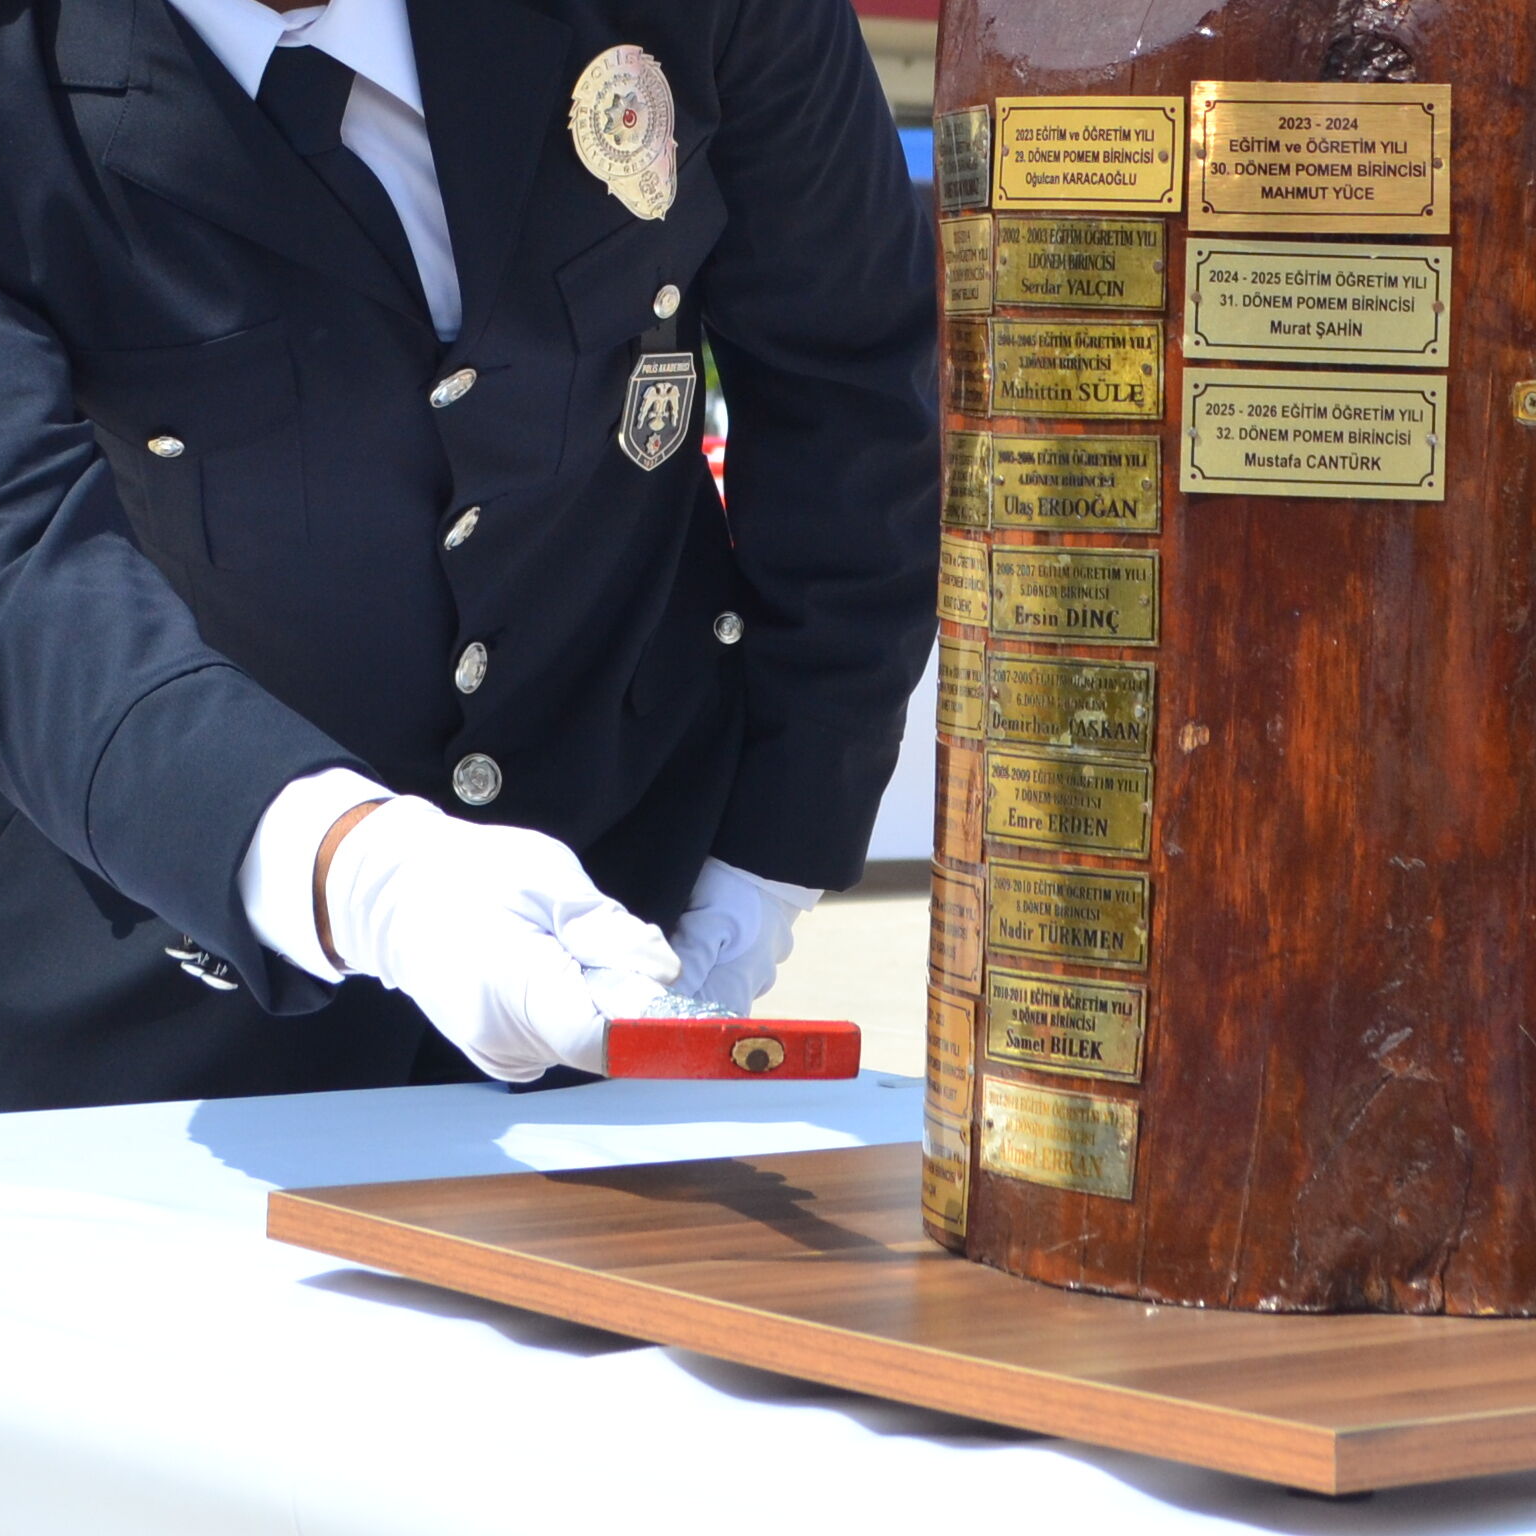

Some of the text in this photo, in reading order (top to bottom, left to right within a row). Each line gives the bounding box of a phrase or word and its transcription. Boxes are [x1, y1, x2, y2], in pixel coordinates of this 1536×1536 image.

[1016, 125, 1154, 142] 2023 EĞİTİM ve ÖĞRETİM YILI
[1278, 117, 1312, 130] 2023
[1325, 117, 1358, 130] 2024
[1028, 147, 1060, 163] DÖNEM
[1063, 151, 1100, 163] POMEM
[1103, 147, 1153, 164] BİRİNCİSİ
[1229, 137, 1408, 154] EĞİTİM ve ÖĞRETİM YILI
[1026, 169, 1137, 187] Oğulcan KARACAOĞLU
[1210, 160, 1427, 177] 30. DÖNEM POMEM BİRİNCİSİ
[1261, 184, 1374, 200] MAHMUT YÜCE
[1021, 278, 1124, 299] Serdar YALÇIN
[1209, 270, 1239, 283] 2024
[1251, 272, 1281, 285] 2025
[1285, 270, 1331, 287] EĞİTİM
[1336, 271, 1398, 289] ÖĞRETİM
[1401, 276, 1427, 290] YILI
[1220, 292, 1415, 313] 31. DÖNEM POMEM BİRİNCİSİ
[1270, 318, 1363, 339] Murat ŞAHİN
[1001, 381, 1072, 400] Muhittin
[1078, 378, 1144, 402] SÜLE
[1205, 403, 1236, 416] 2025
[1247, 404, 1278, 418] 2026
[1281, 403, 1328, 420] EĞİTİM
[1331, 404, 1395, 422] ÖĞRETİM
[1398, 409, 1424, 422] YILI
[1216, 425, 1411, 445] 32. DÖNEM POMEM BİRİNCİSİ
[1244, 453, 1382, 471] Mustafa CANTÜRK
[1004, 495, 1033, 520] Ulaş
[1038, 494, 1138, 519] ERDOĞAN
[1015, 604, 1120, 634] Ersin DİNÇ
[1008, 807, 1108, 837] Emre ERDEN
[999, 917, 1034, 941] Nadir
[1038, 920, 1124, 950] TÜRKMEN
[1006, 1028, 1103, 1060] Samet BİLEK
